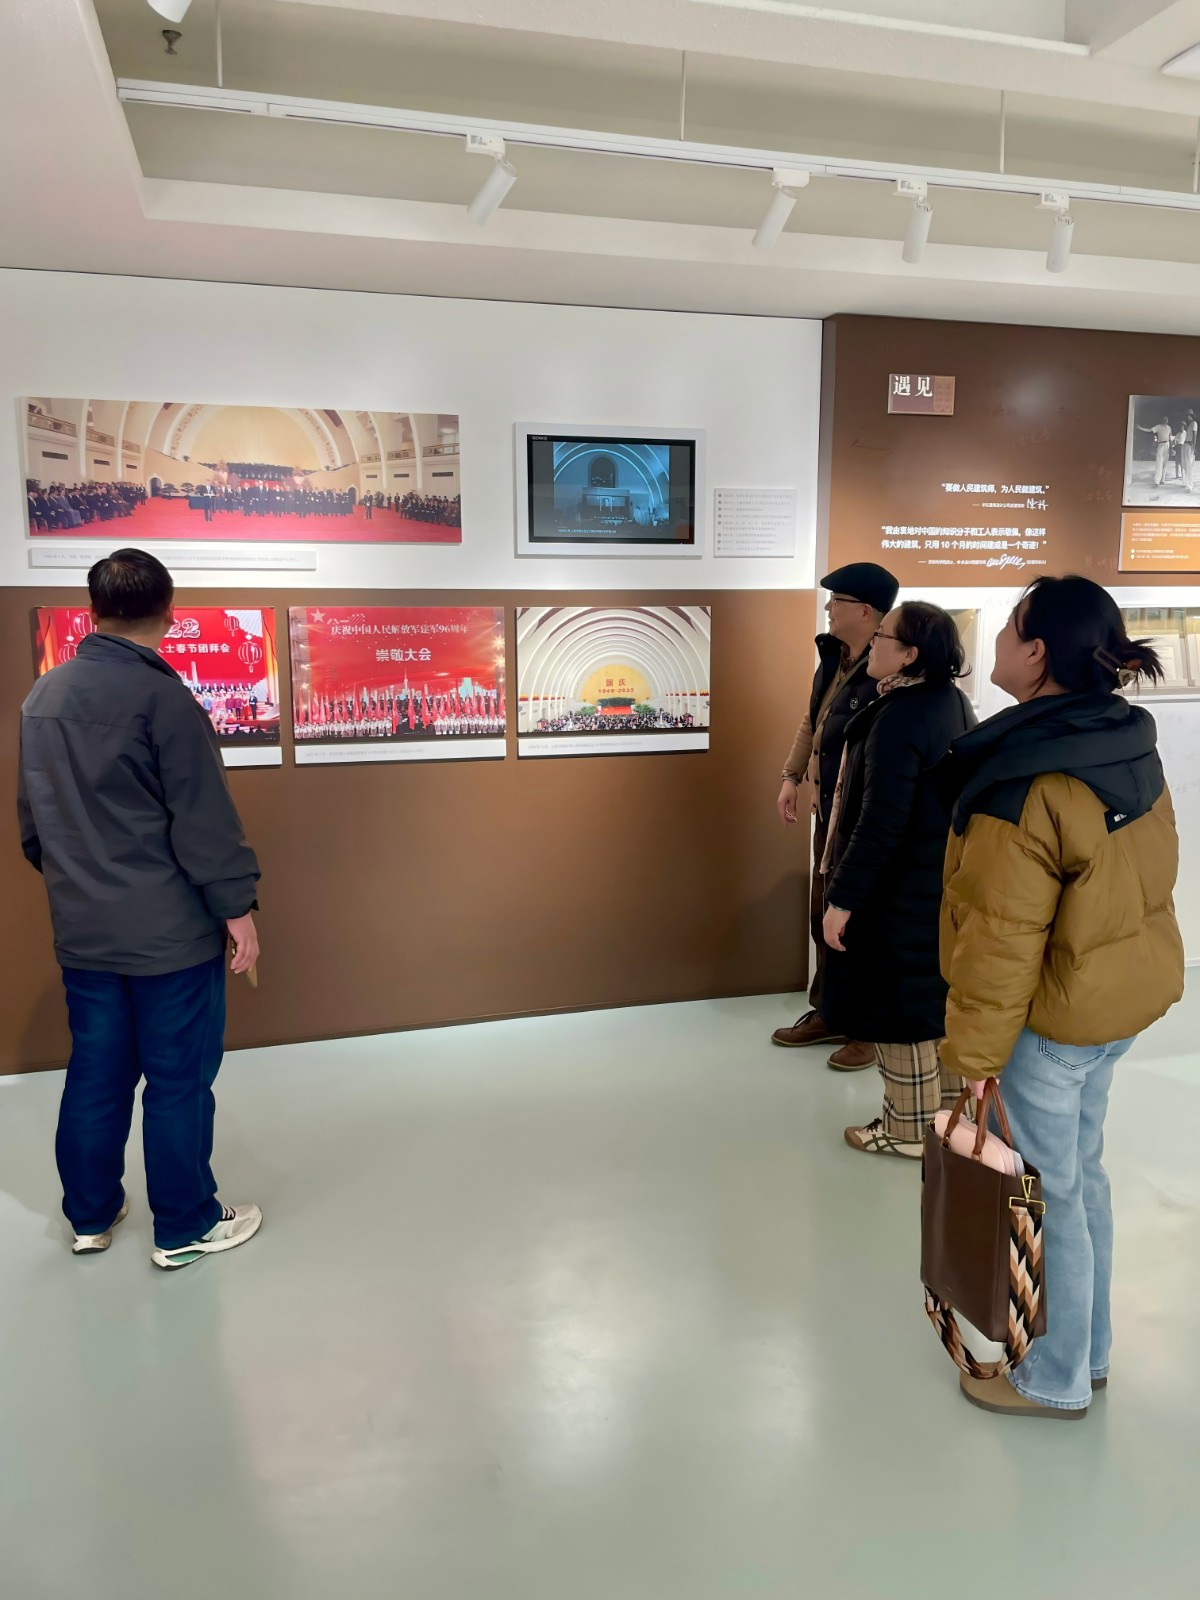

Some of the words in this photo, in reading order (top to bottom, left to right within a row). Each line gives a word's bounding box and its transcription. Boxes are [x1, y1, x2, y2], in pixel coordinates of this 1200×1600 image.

[893, 375, 934, 397] 遇见
[331, 623, 470, 636] 庆祝中国人民解放军建军96周年
[375, 648, 432, 663] 崇敬大会
[605, 678, 627, 687] 国庆
